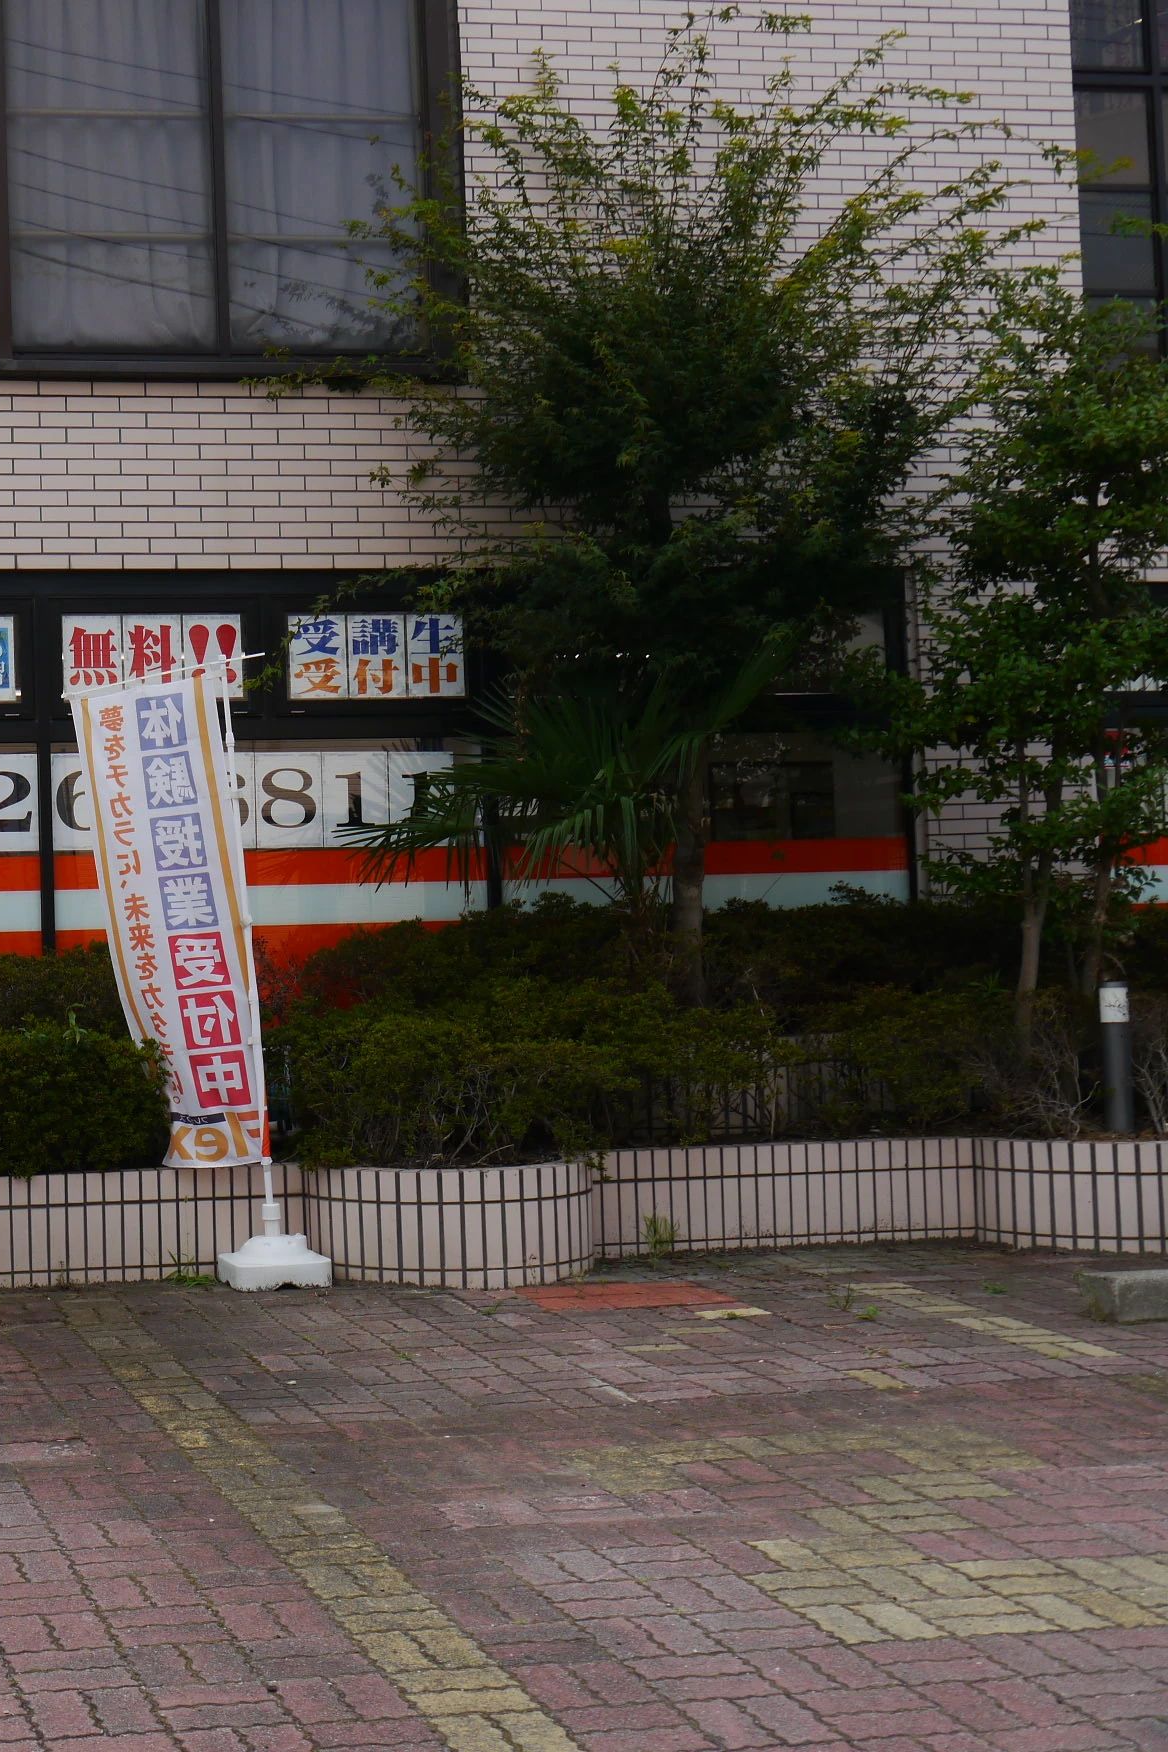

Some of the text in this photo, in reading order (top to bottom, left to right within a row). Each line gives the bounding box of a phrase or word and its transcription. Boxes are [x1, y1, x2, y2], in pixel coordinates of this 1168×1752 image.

[295, 617, 457, 656] 受講生
[294, 657, 458, 694] 受付中
